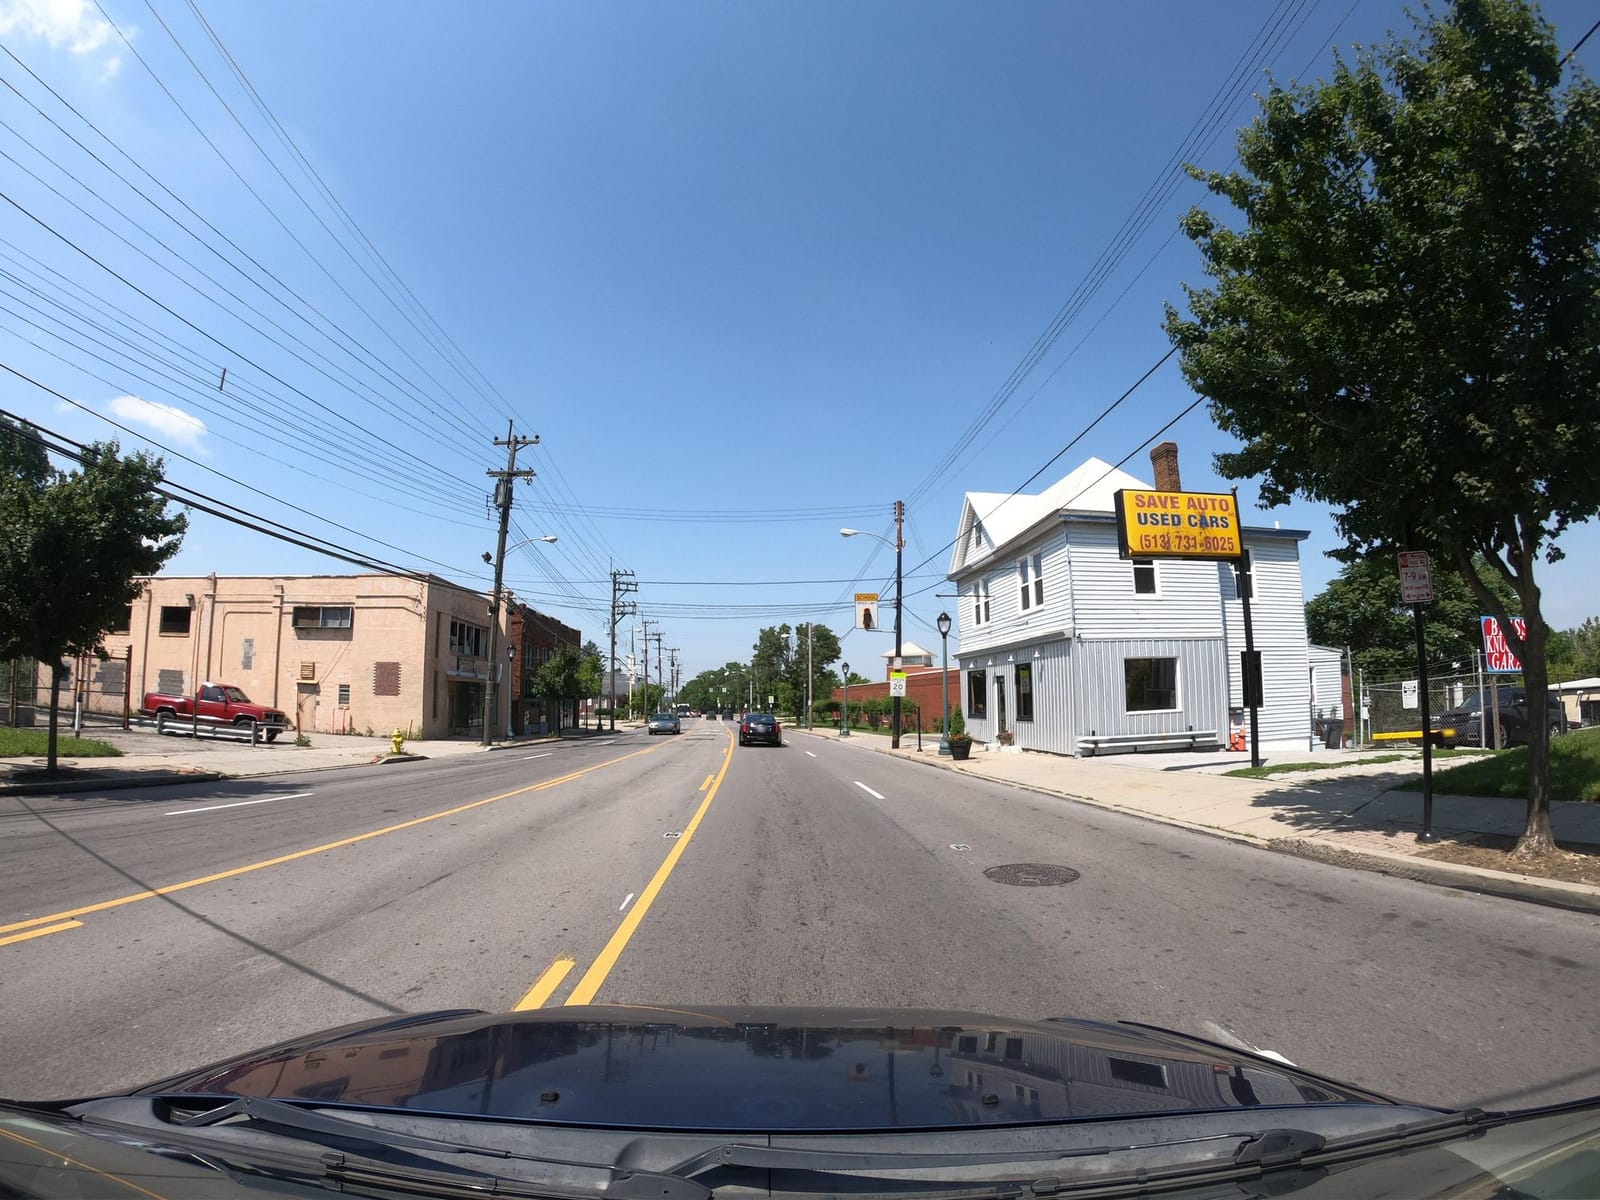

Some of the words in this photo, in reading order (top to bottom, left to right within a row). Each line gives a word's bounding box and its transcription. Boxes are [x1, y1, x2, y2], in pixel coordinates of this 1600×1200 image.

[1135, 495, 1180, 509] SAVE
[1187, 497, 1230, 512] AUTO
[1138, 513, 1181, 526] USED
[1188, 514, 1229, 528] CARS
[1140, 534, 1171, 550] (513)
[892, 683, 903, 691] 20
